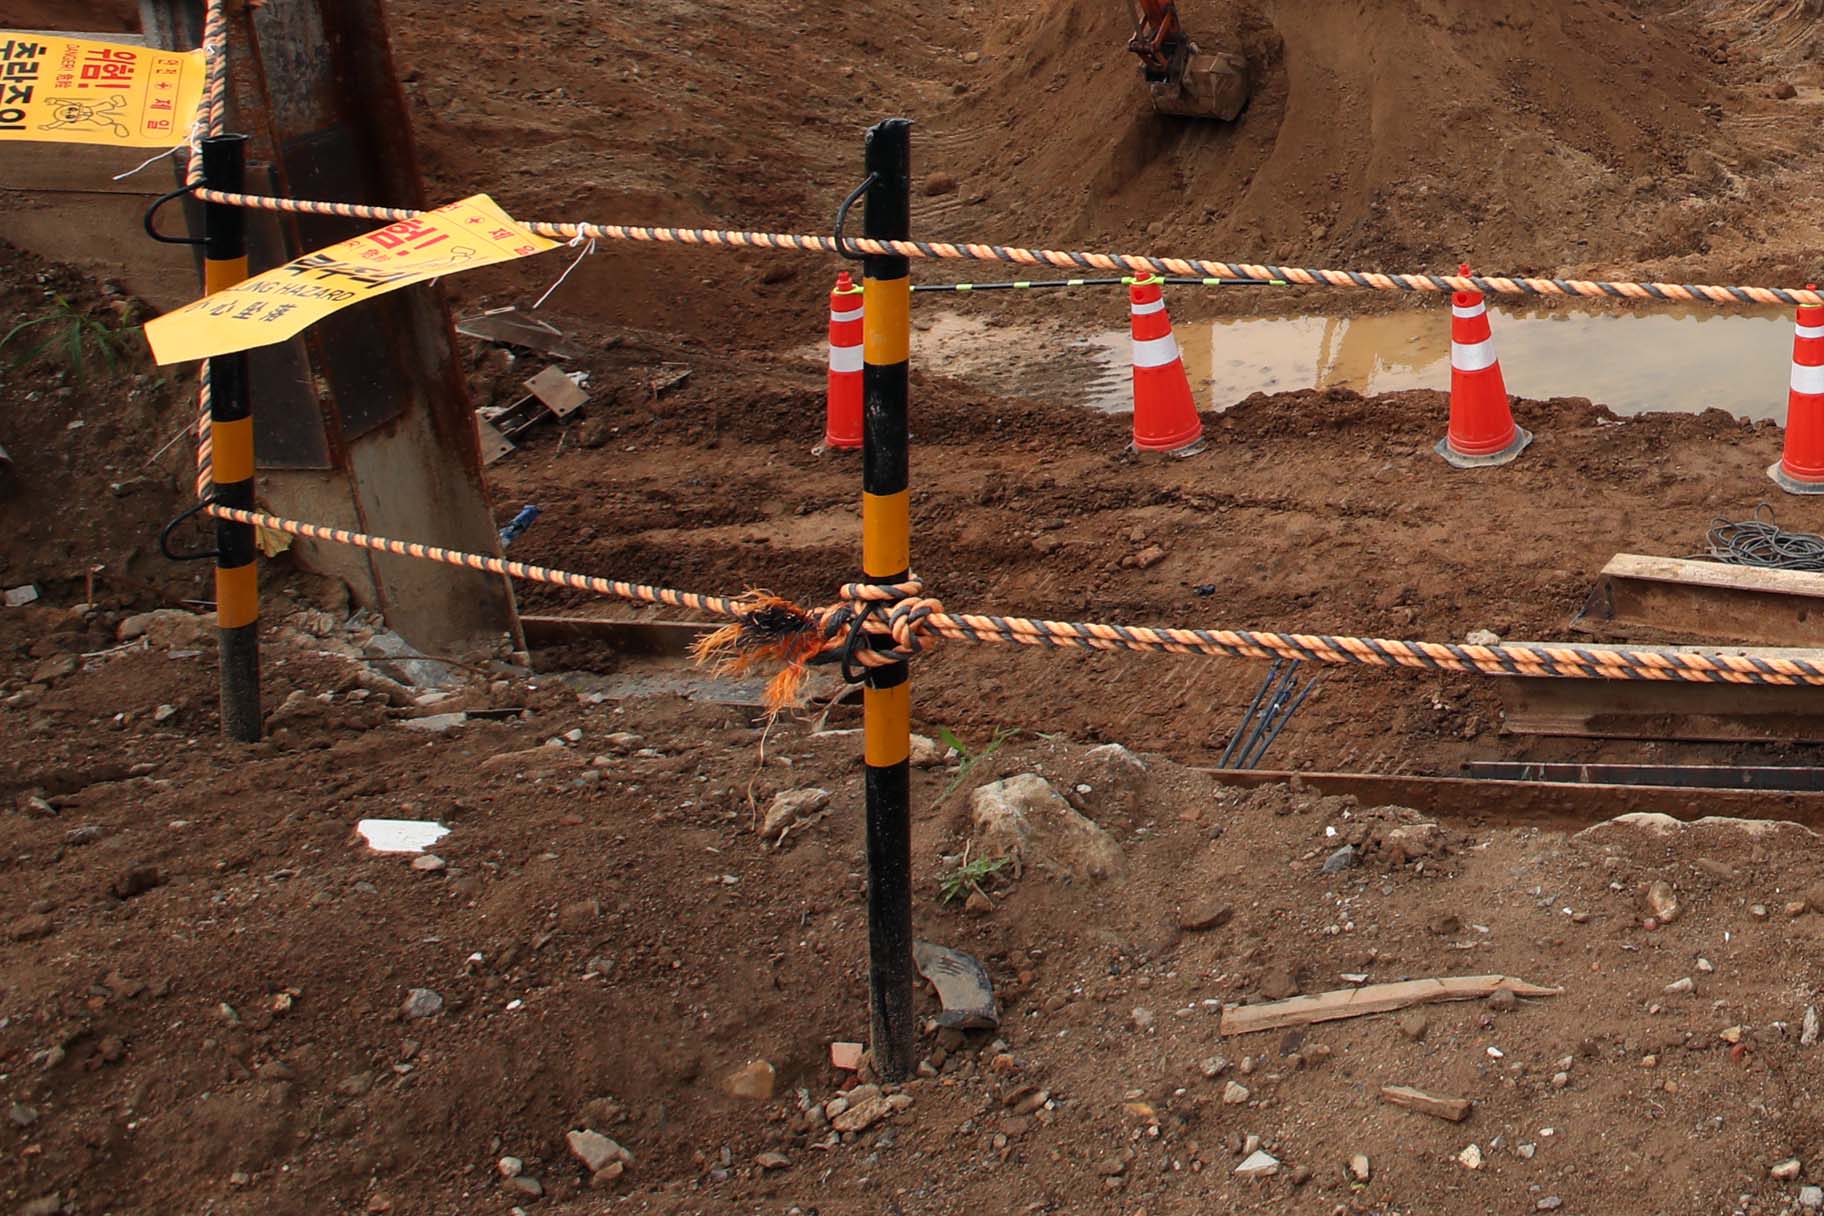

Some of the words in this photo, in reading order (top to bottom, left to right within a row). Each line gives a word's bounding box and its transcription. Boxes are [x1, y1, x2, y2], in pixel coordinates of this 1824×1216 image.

[77, 48, 137, 89] 위험!
[147, 97, 172, 131] 제일
[365, 218, 450, 257] 험!
[277, 282, 356, 303] HAZARD
